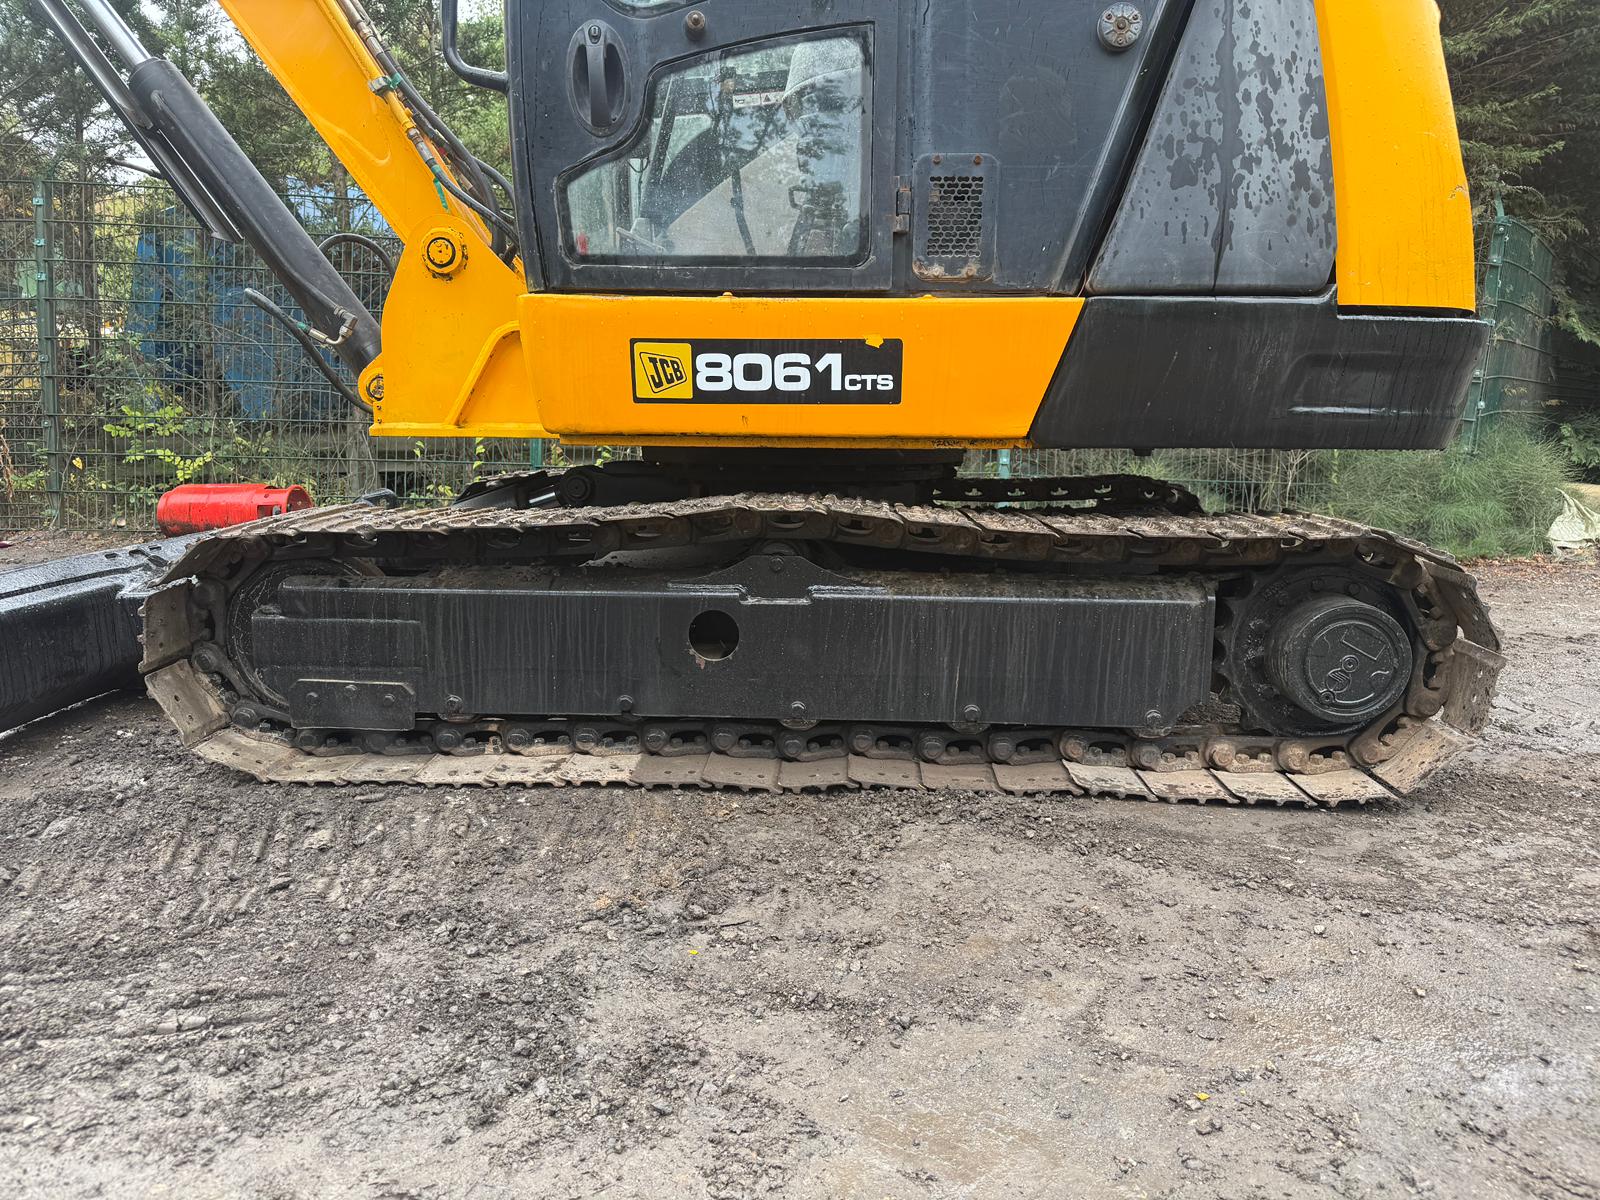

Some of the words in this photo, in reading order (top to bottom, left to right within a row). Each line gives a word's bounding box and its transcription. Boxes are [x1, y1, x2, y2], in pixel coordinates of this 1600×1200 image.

[646, 355, 685, 389] JCB
[695, 353, 842, 391] 8061
[844, 374, 894, 391] CTS
